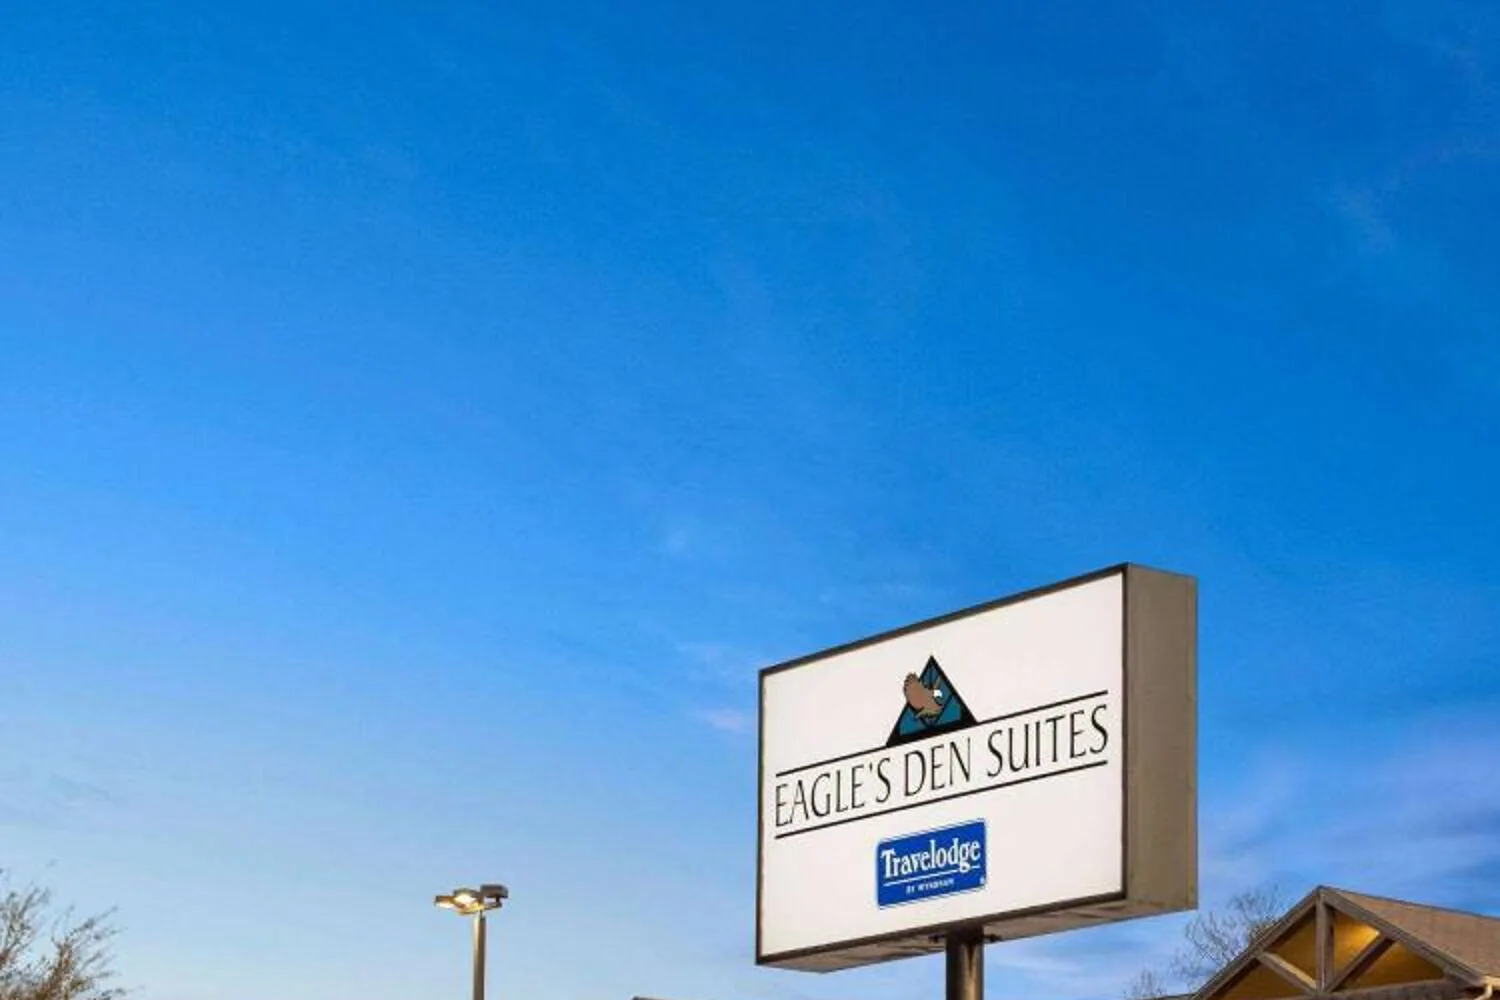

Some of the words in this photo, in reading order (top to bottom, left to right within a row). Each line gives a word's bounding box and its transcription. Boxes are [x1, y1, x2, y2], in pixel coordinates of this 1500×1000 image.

[775, 757, 891, 828] EAGLE'S
[904, 736, 972, 798] DEN
[987, 703, 1109, 779] SUITES
[881, 837, 981, 879] Travelodge
